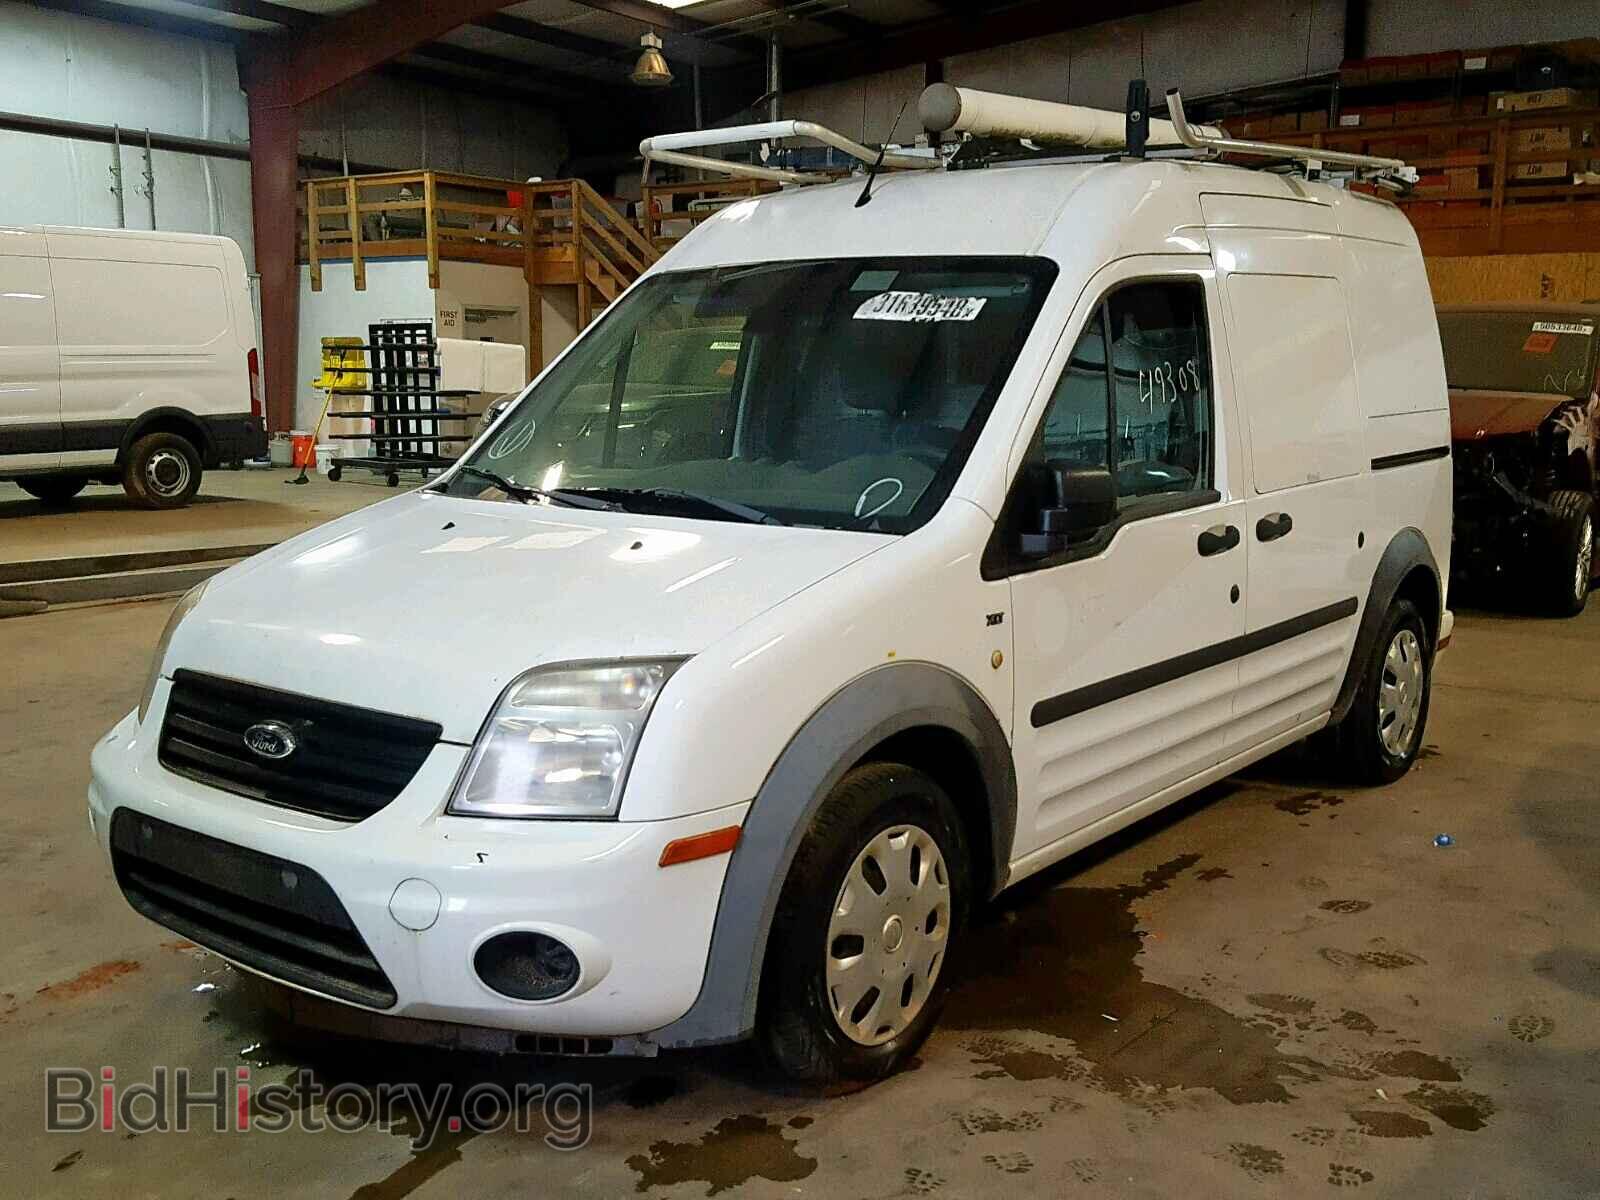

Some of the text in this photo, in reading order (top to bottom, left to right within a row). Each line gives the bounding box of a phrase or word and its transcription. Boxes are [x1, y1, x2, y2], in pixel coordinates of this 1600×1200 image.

[440, 311, 458, 319] FIRST
[443, 319, 456, 327] AID
[1139, 359, 1200, 415] 49308
